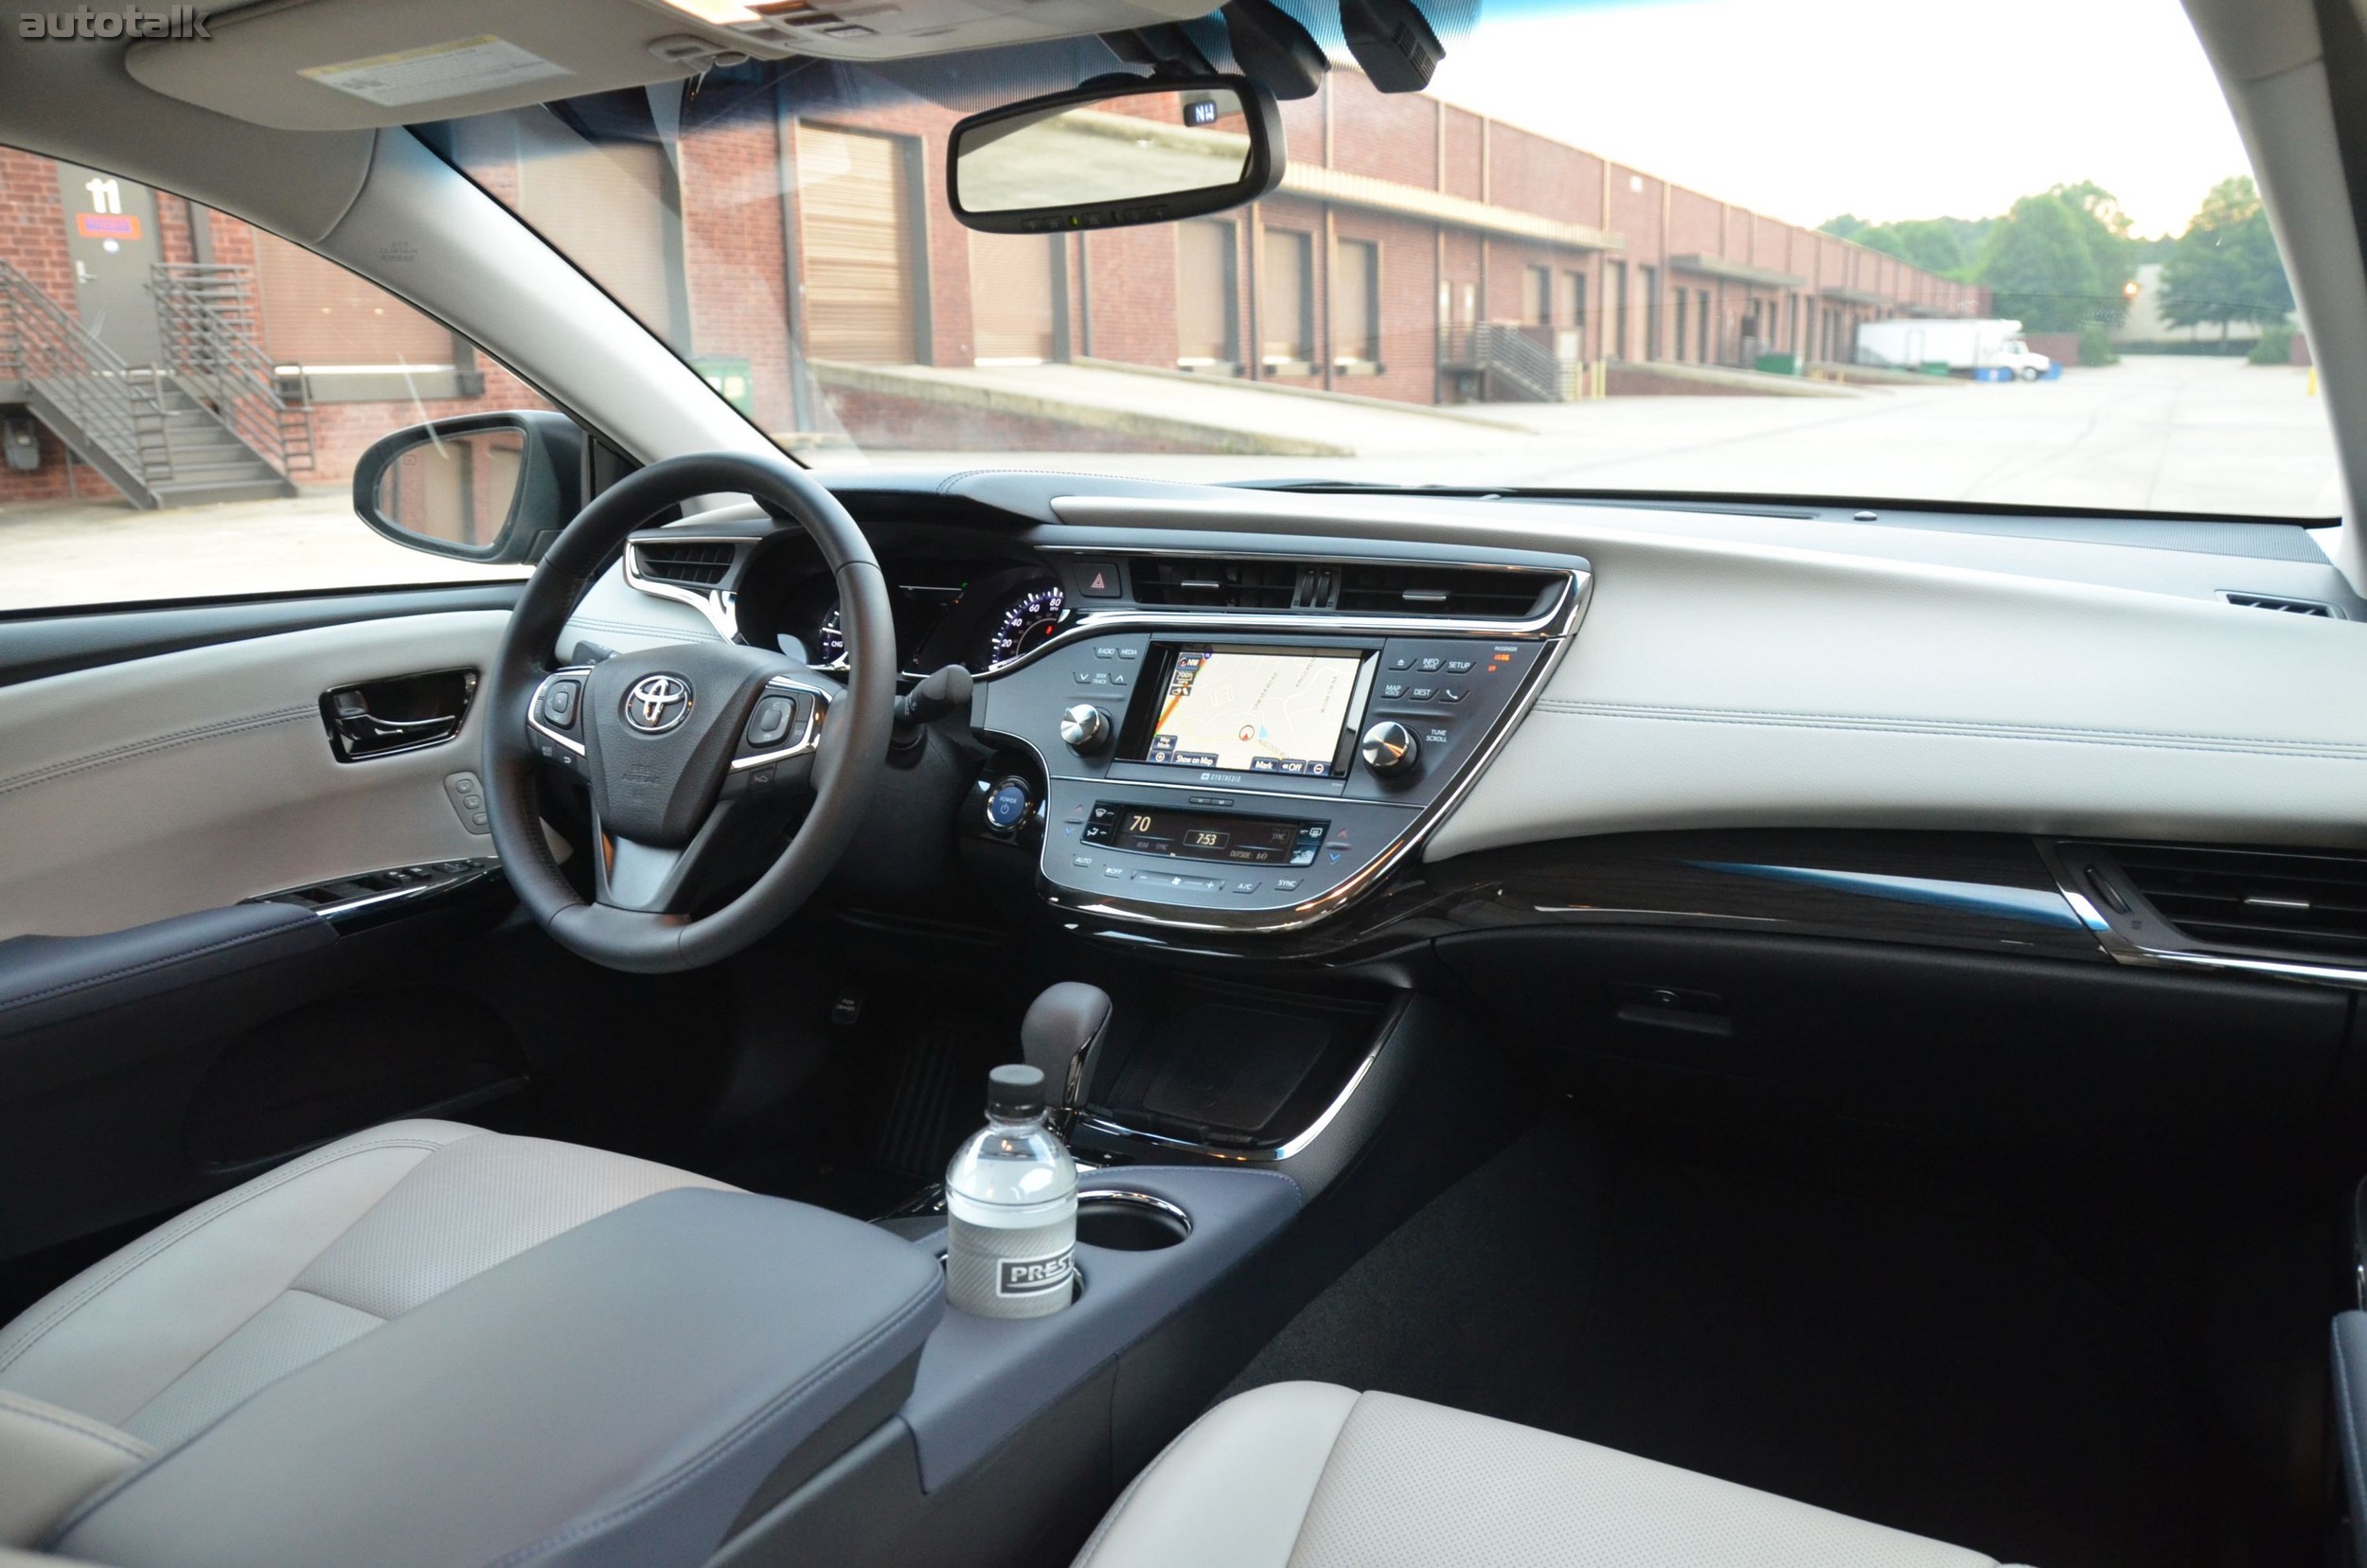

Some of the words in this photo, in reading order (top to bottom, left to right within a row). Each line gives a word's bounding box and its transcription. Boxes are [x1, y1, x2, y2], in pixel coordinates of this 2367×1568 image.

[1195, 104, 1215, 122] NW
[85, 178, 122, 214] 11
[1049, 597, 1061, 607] 80
[1028, 603, 1041, 613] 60
[1011, 618, 1023, 628] 40
[1001, 639, 1013, 648] 20
[1186, 658, 1200, 667] NW
[1448, 661, 1471, 669] SETUP
[1175, 755, 1192, 763] Show
[1200, 757, 1214, 766] Map
[1255, 760, 1273, 770] Mark
[1289, 762, 1303, 773] Off
[1130, 815, 1151, 832] 70
[1196, 833, 1217, 846] 7:53
